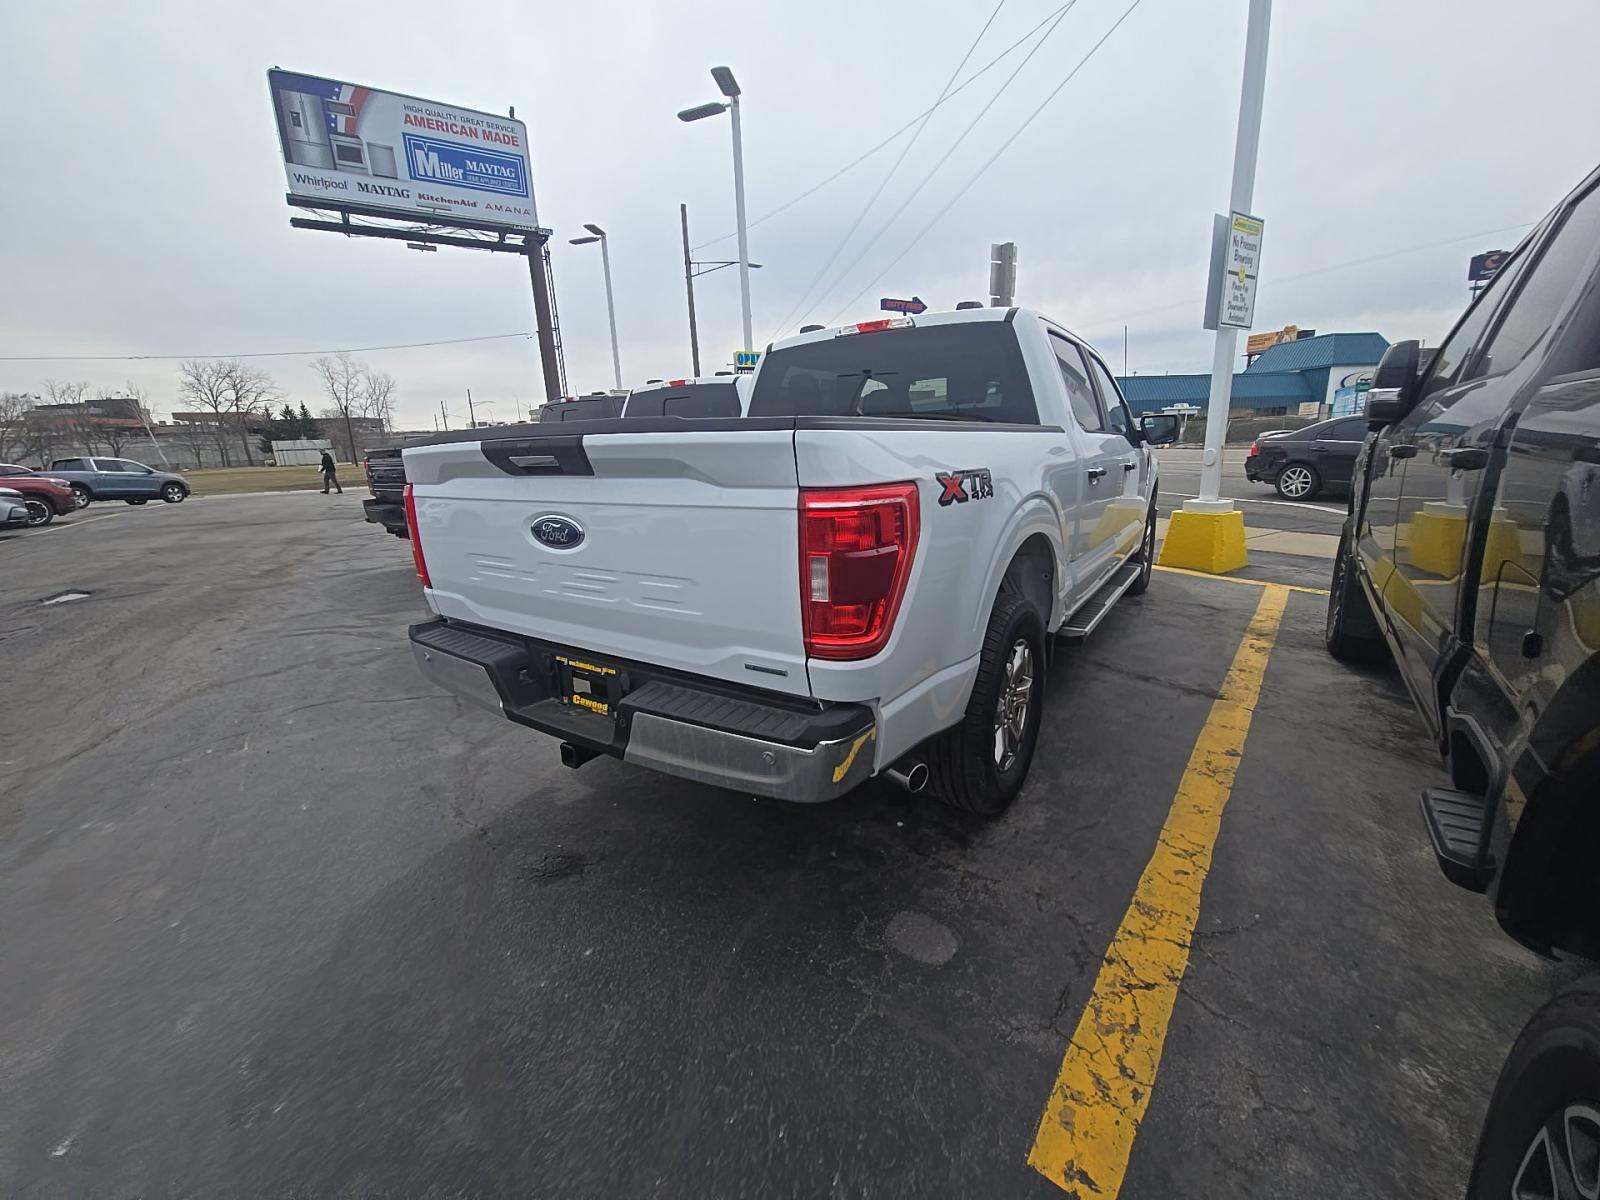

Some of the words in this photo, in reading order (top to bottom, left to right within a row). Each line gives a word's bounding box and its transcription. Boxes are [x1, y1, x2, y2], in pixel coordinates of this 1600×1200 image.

[403, 104, 423, 114] HIGH
[460, 116, 484, 126] GREAT
[404, 113, 479, 139] AMERICAN
[482, 129, 520, 147] MADE
[415, 149, 464, 180] Miller
[465, 160, 515, 178] MAYTAG
[293, 172, 349, 190] Whirlpool
[356, 182, 410, 199] MAYTAG
[417, 192, 479, 208] KitchenAid
[485, 203, 531, 216] AMANA
[541, 522, 568, 542] Ford
[572, 694, 608, 711] Cawood
